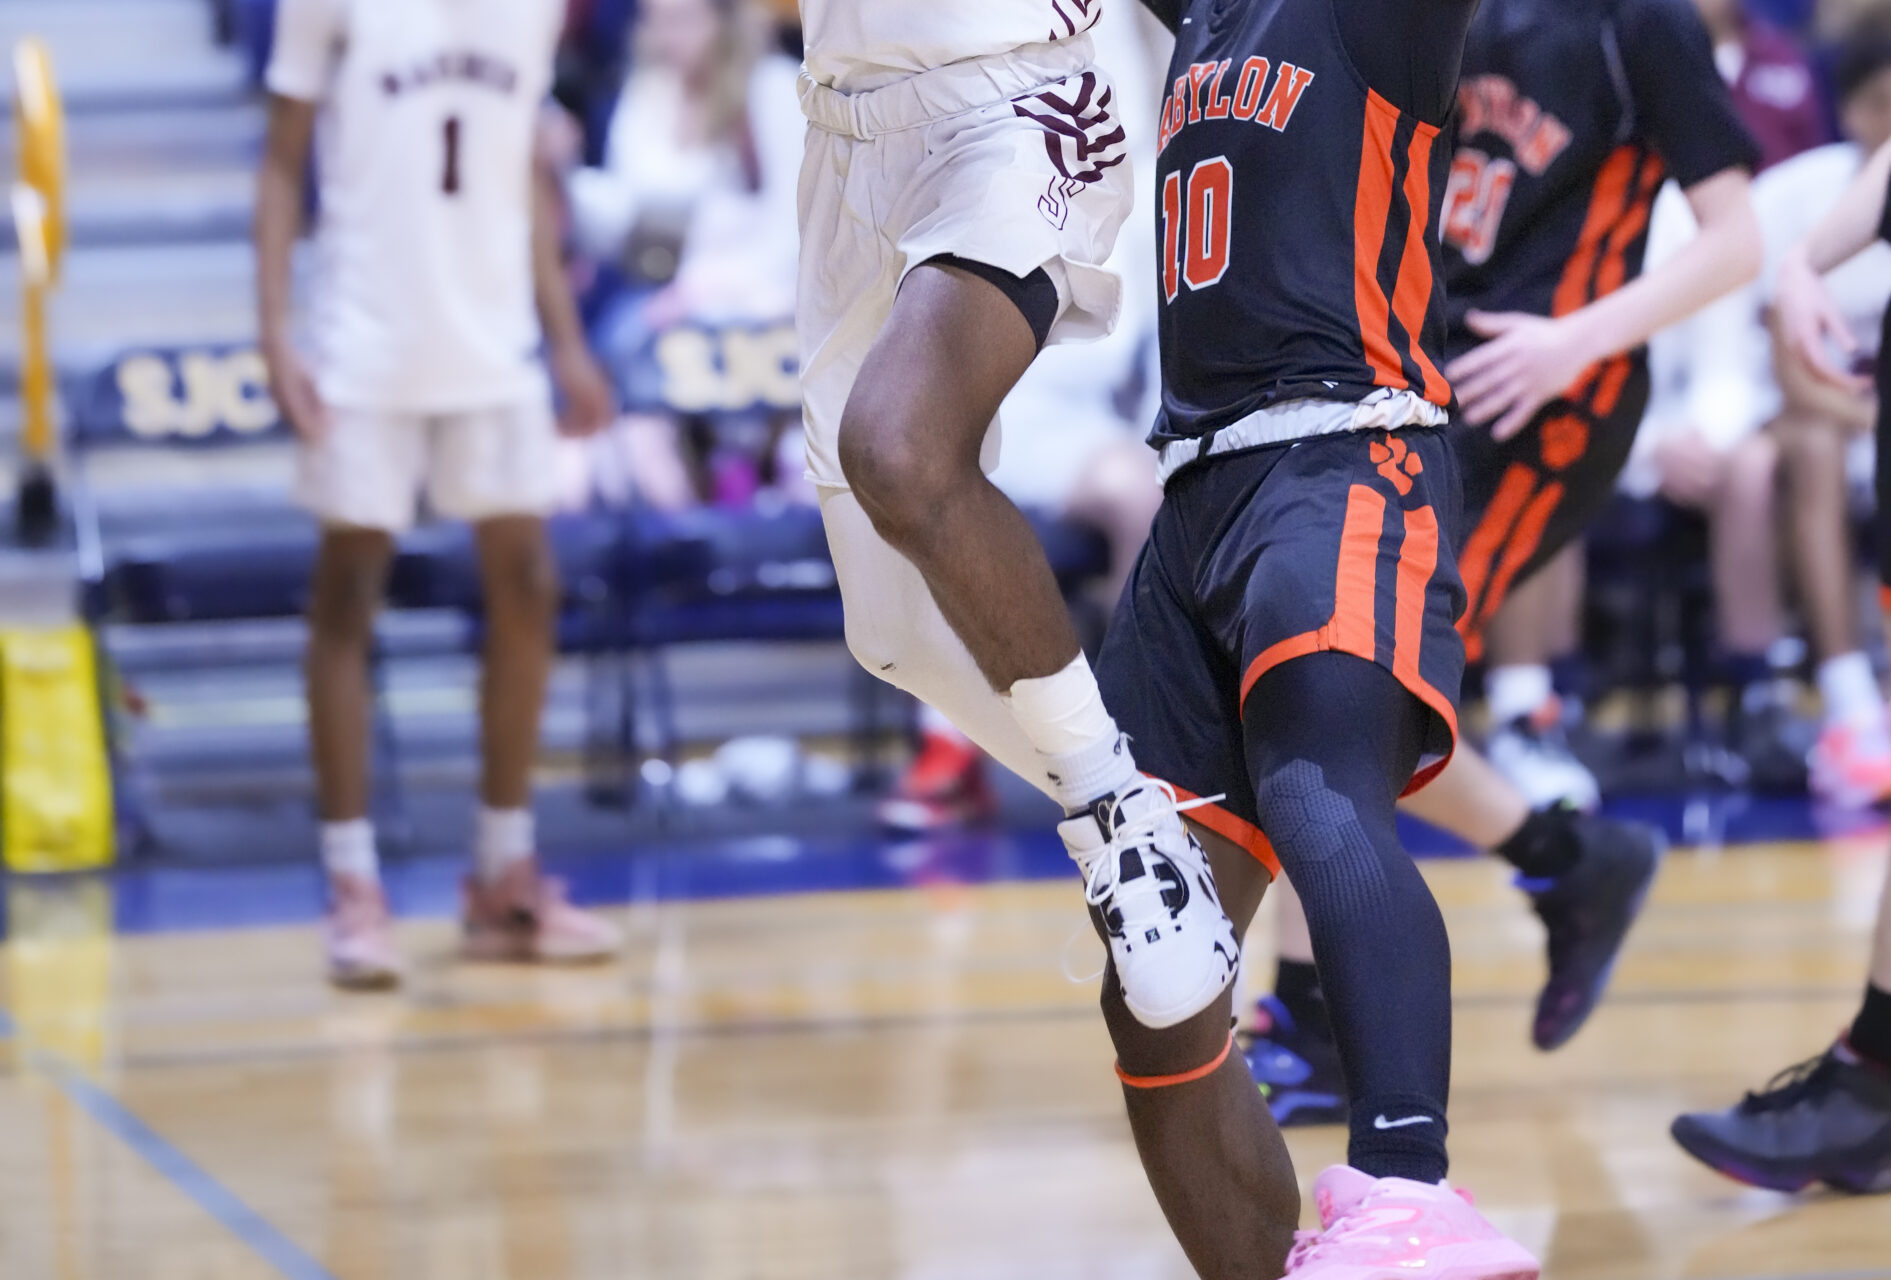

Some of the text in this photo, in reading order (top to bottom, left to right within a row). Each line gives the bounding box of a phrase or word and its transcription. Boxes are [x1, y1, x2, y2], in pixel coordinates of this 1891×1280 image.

[1157, 55, 1315, 158] ABYLON
[441, 115, 460, 196] 1
[1161, 155, 1233, 305] 10
[116, 350, 280, 439] SJC
